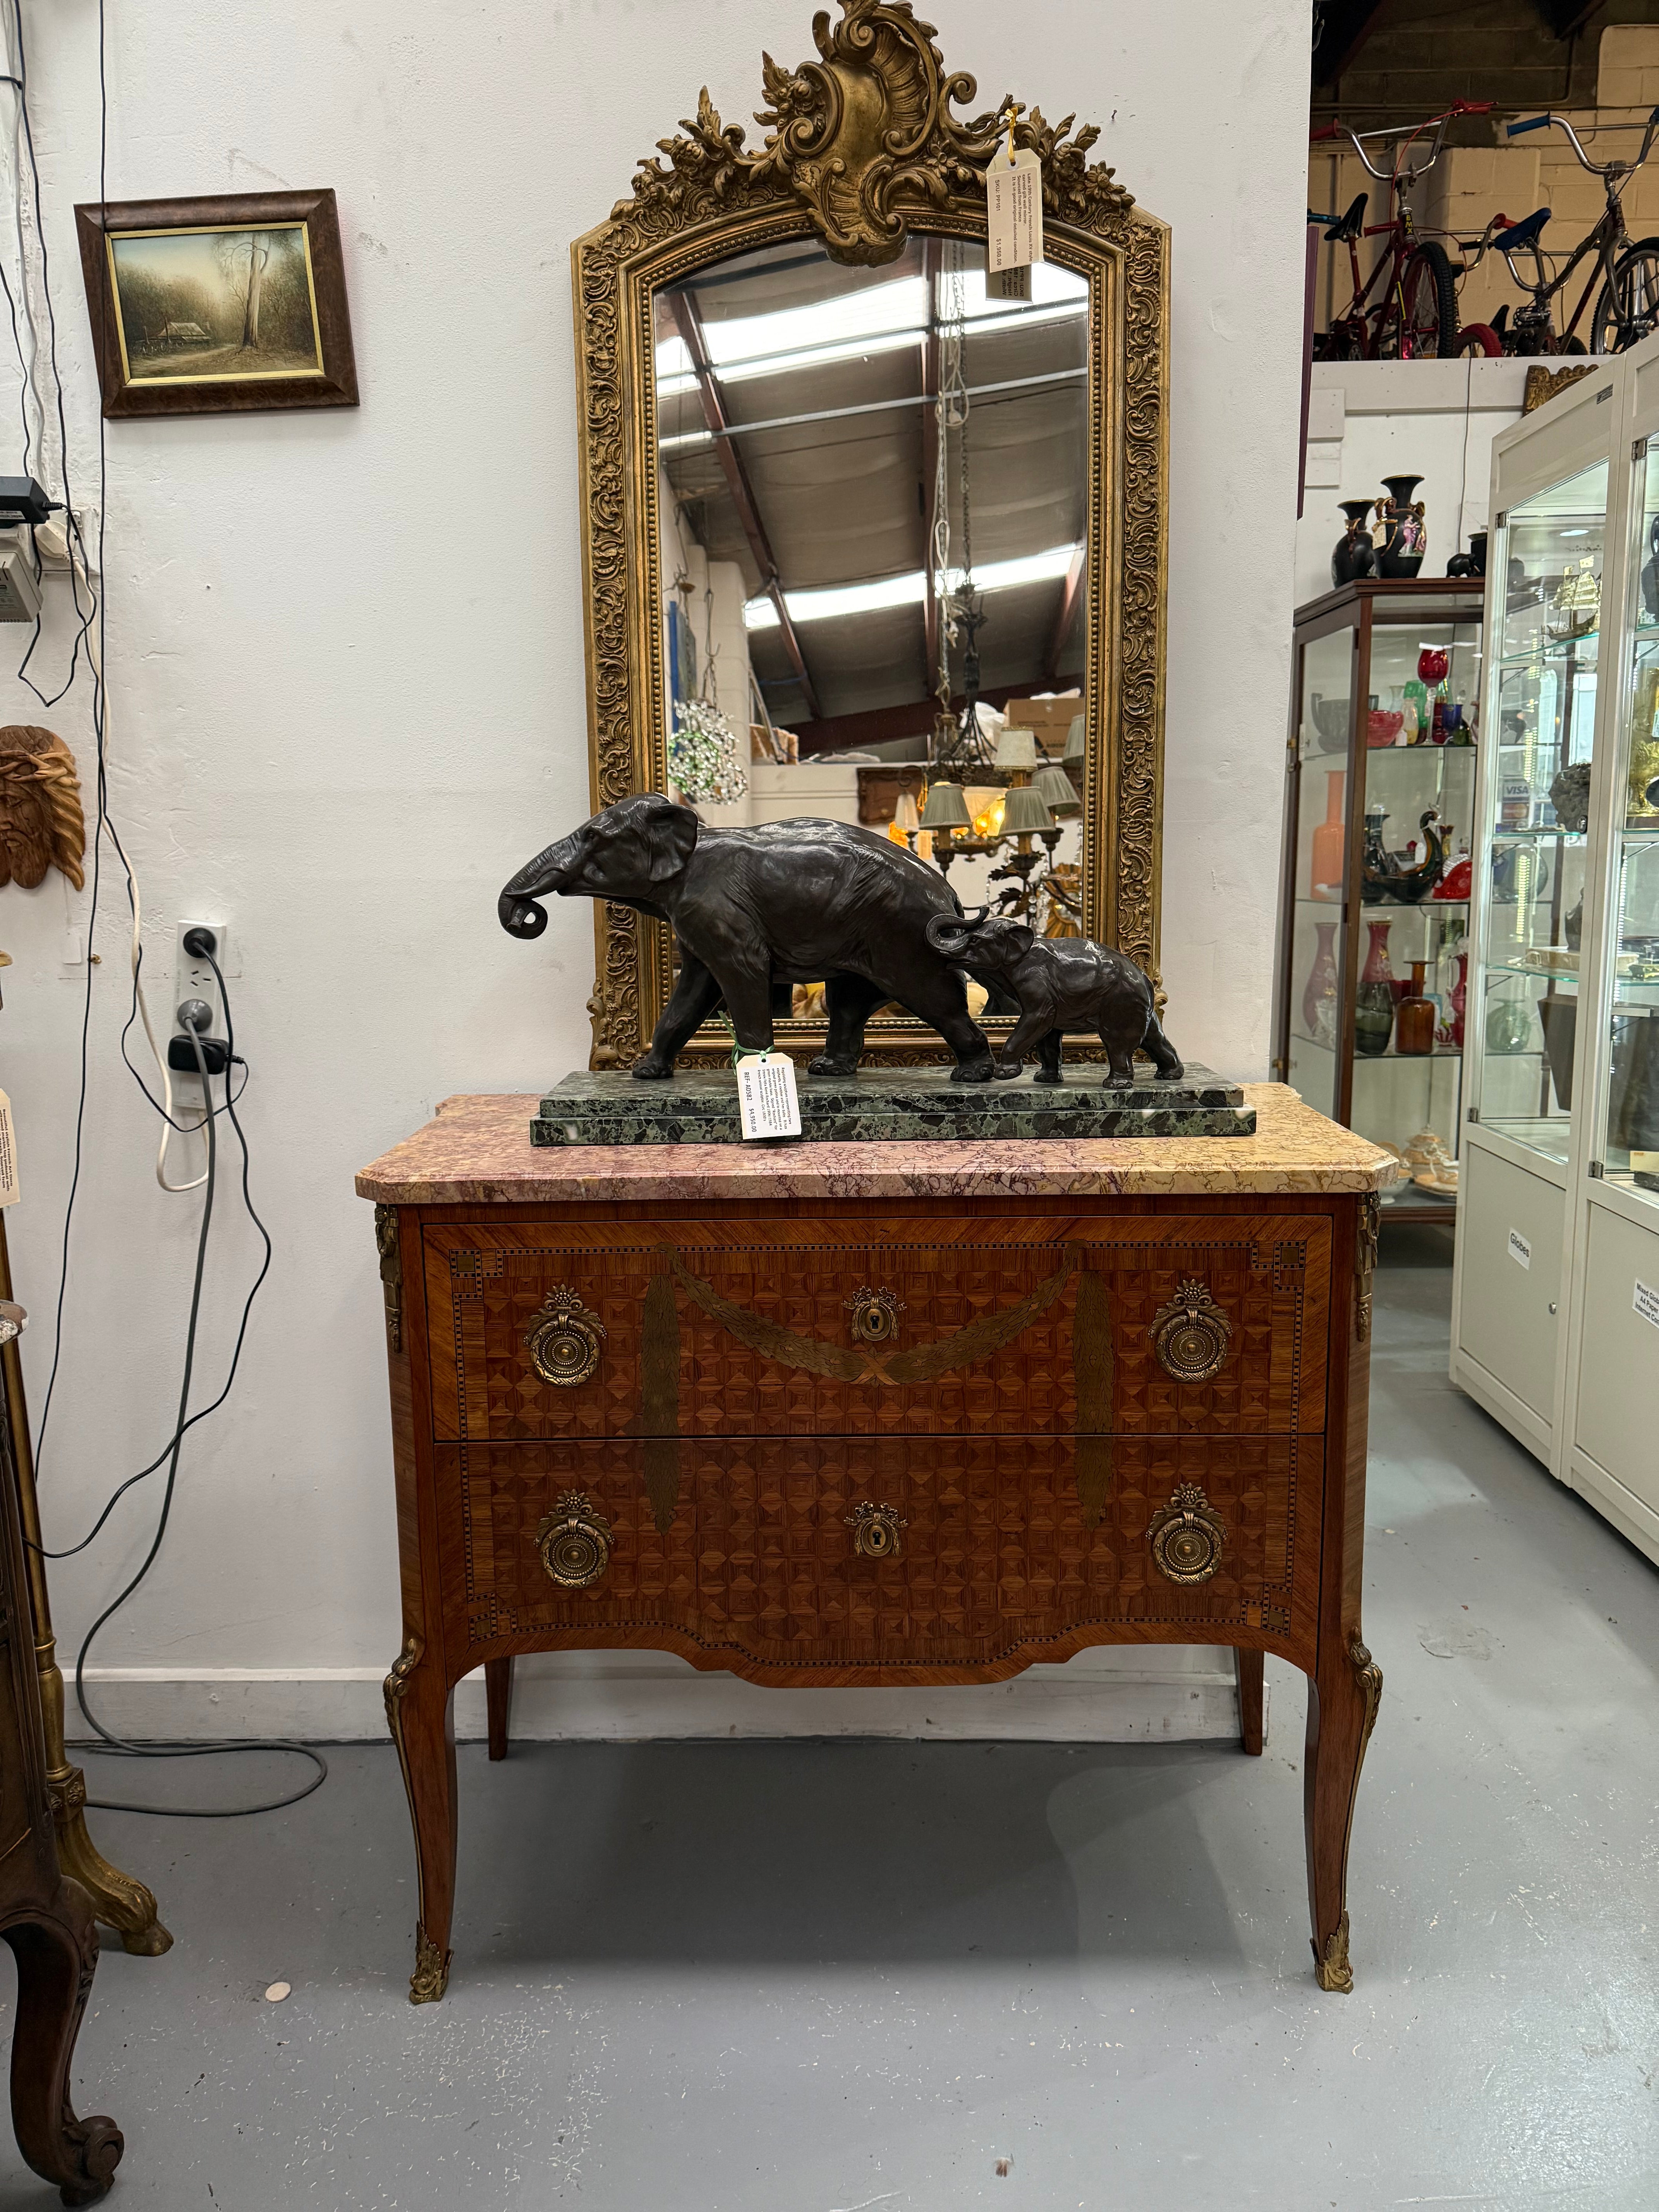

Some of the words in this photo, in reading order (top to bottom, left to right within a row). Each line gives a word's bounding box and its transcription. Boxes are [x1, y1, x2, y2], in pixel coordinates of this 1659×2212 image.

[1405, 215, 1413, 235] BMX
[1506, 785, 1529, 794] VISA
[749, 1108, 757, 1132] $4,950.00
[1510, 1233, 1529, 1257] Globes
[1637, 1283, 1649, 1297] Mixed
[1635, 1301, 1650, 1319] Internet
[1640, 1296, 1645, 1304] A4
[1647, 1300, 1658, 1314] Paper
